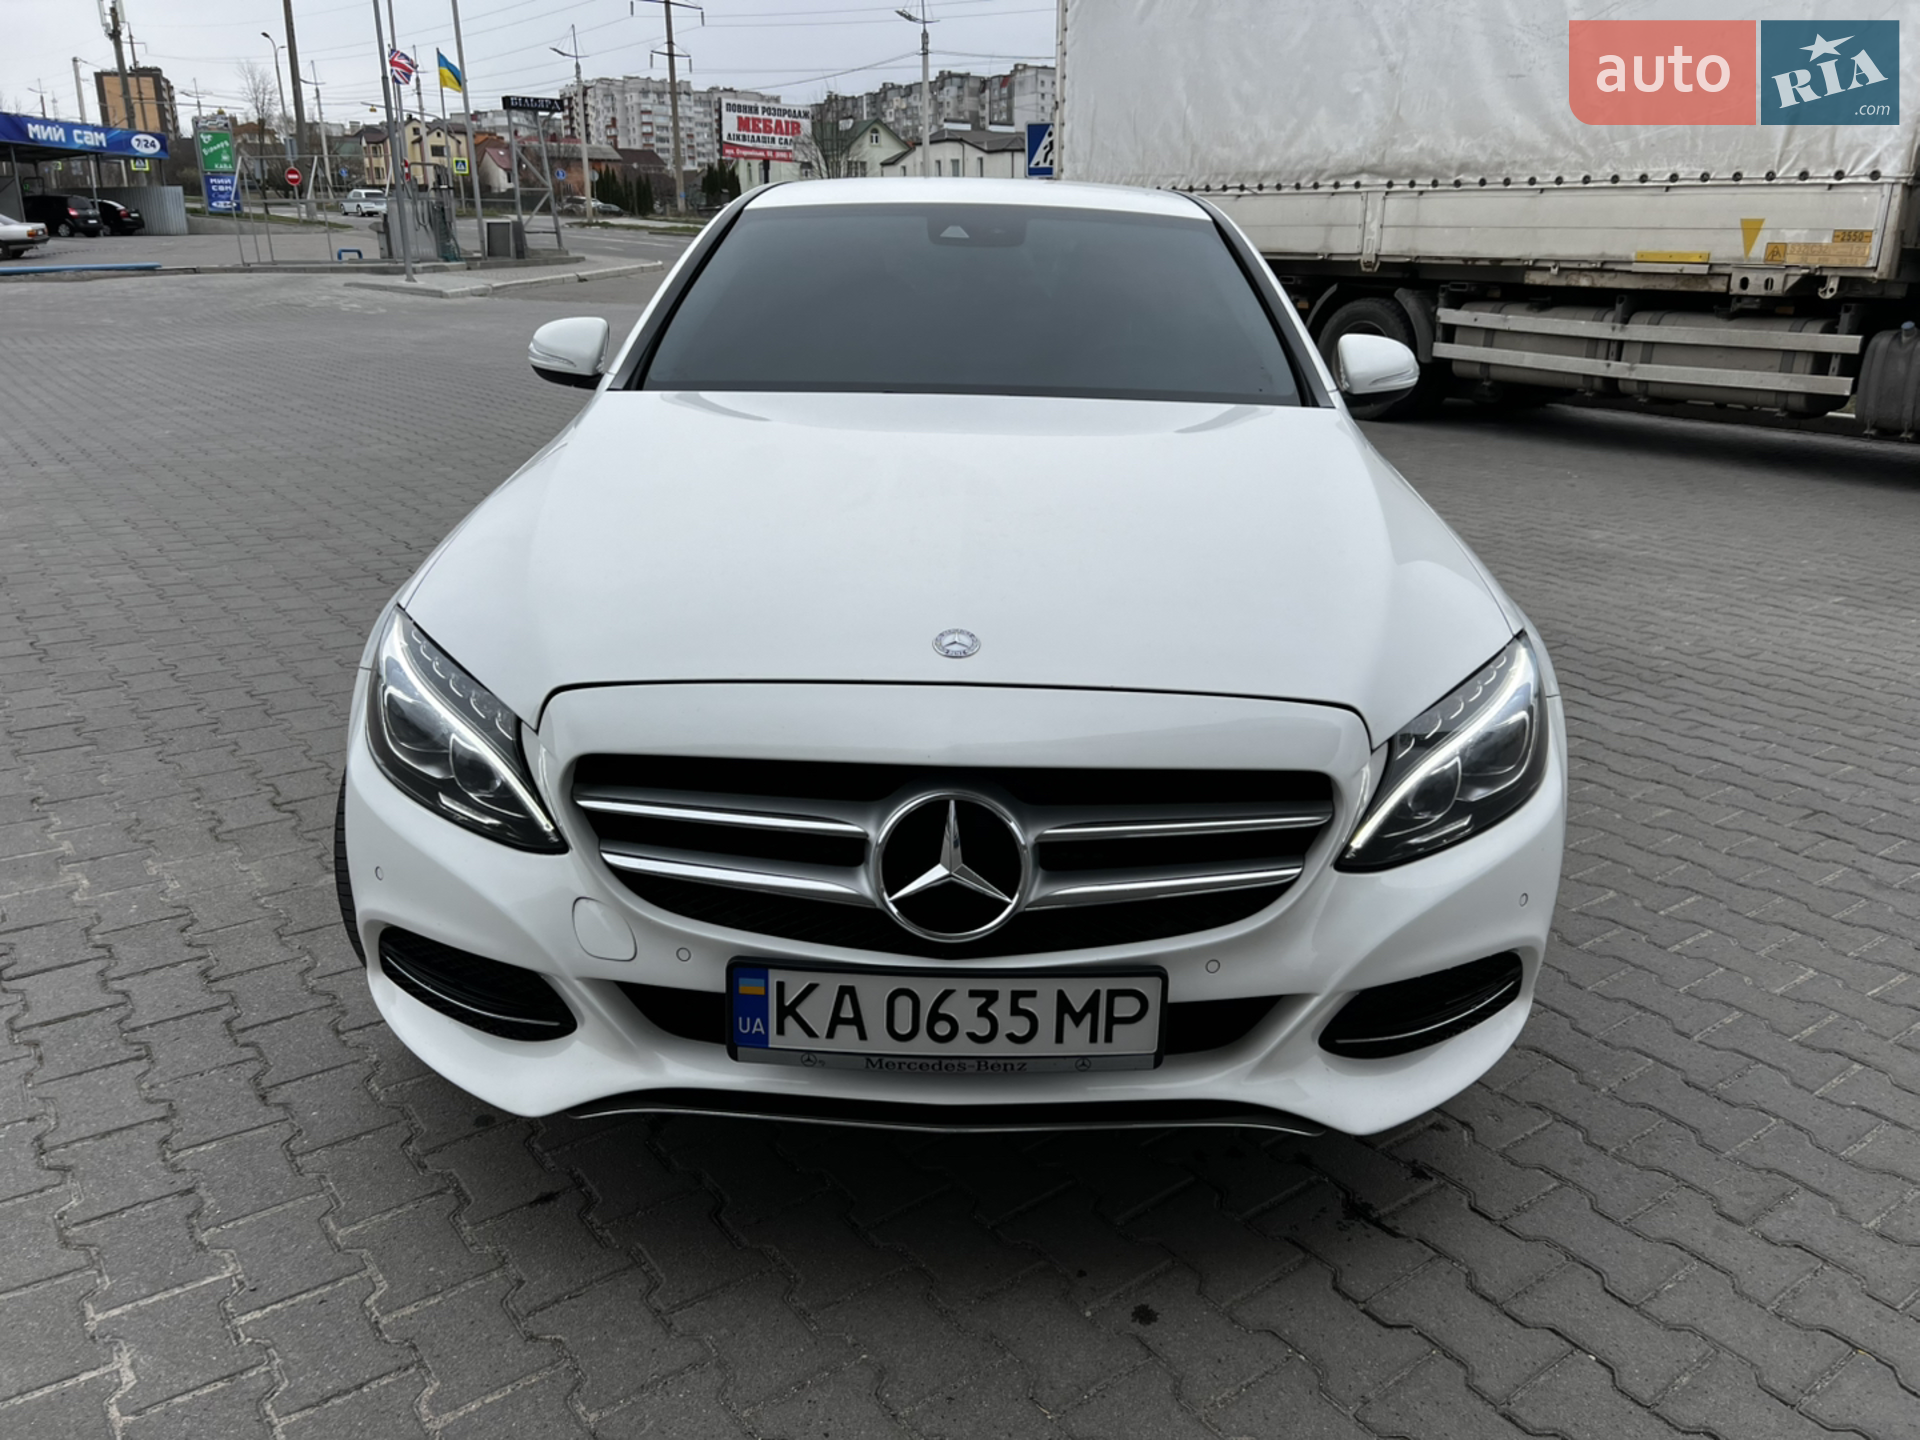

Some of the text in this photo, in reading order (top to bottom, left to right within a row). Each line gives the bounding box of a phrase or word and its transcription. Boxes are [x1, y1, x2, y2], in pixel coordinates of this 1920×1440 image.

[510, 96, 561, 111] БІЛЬЯРД
[725, 102, 811, 120] ПОВНИЙ РОЗПРОДАЖ
[736, 115, 802, 136] МЕБЛІВ
[726, 132, 776, 145] ЛІКВІДАЦІЯ
[775, 980, 1150, 1045] KA 0635 MP
[738, 1016, 766, 1036] UA
[864, 1057, 1028, 1073] Mercedes-Benz
